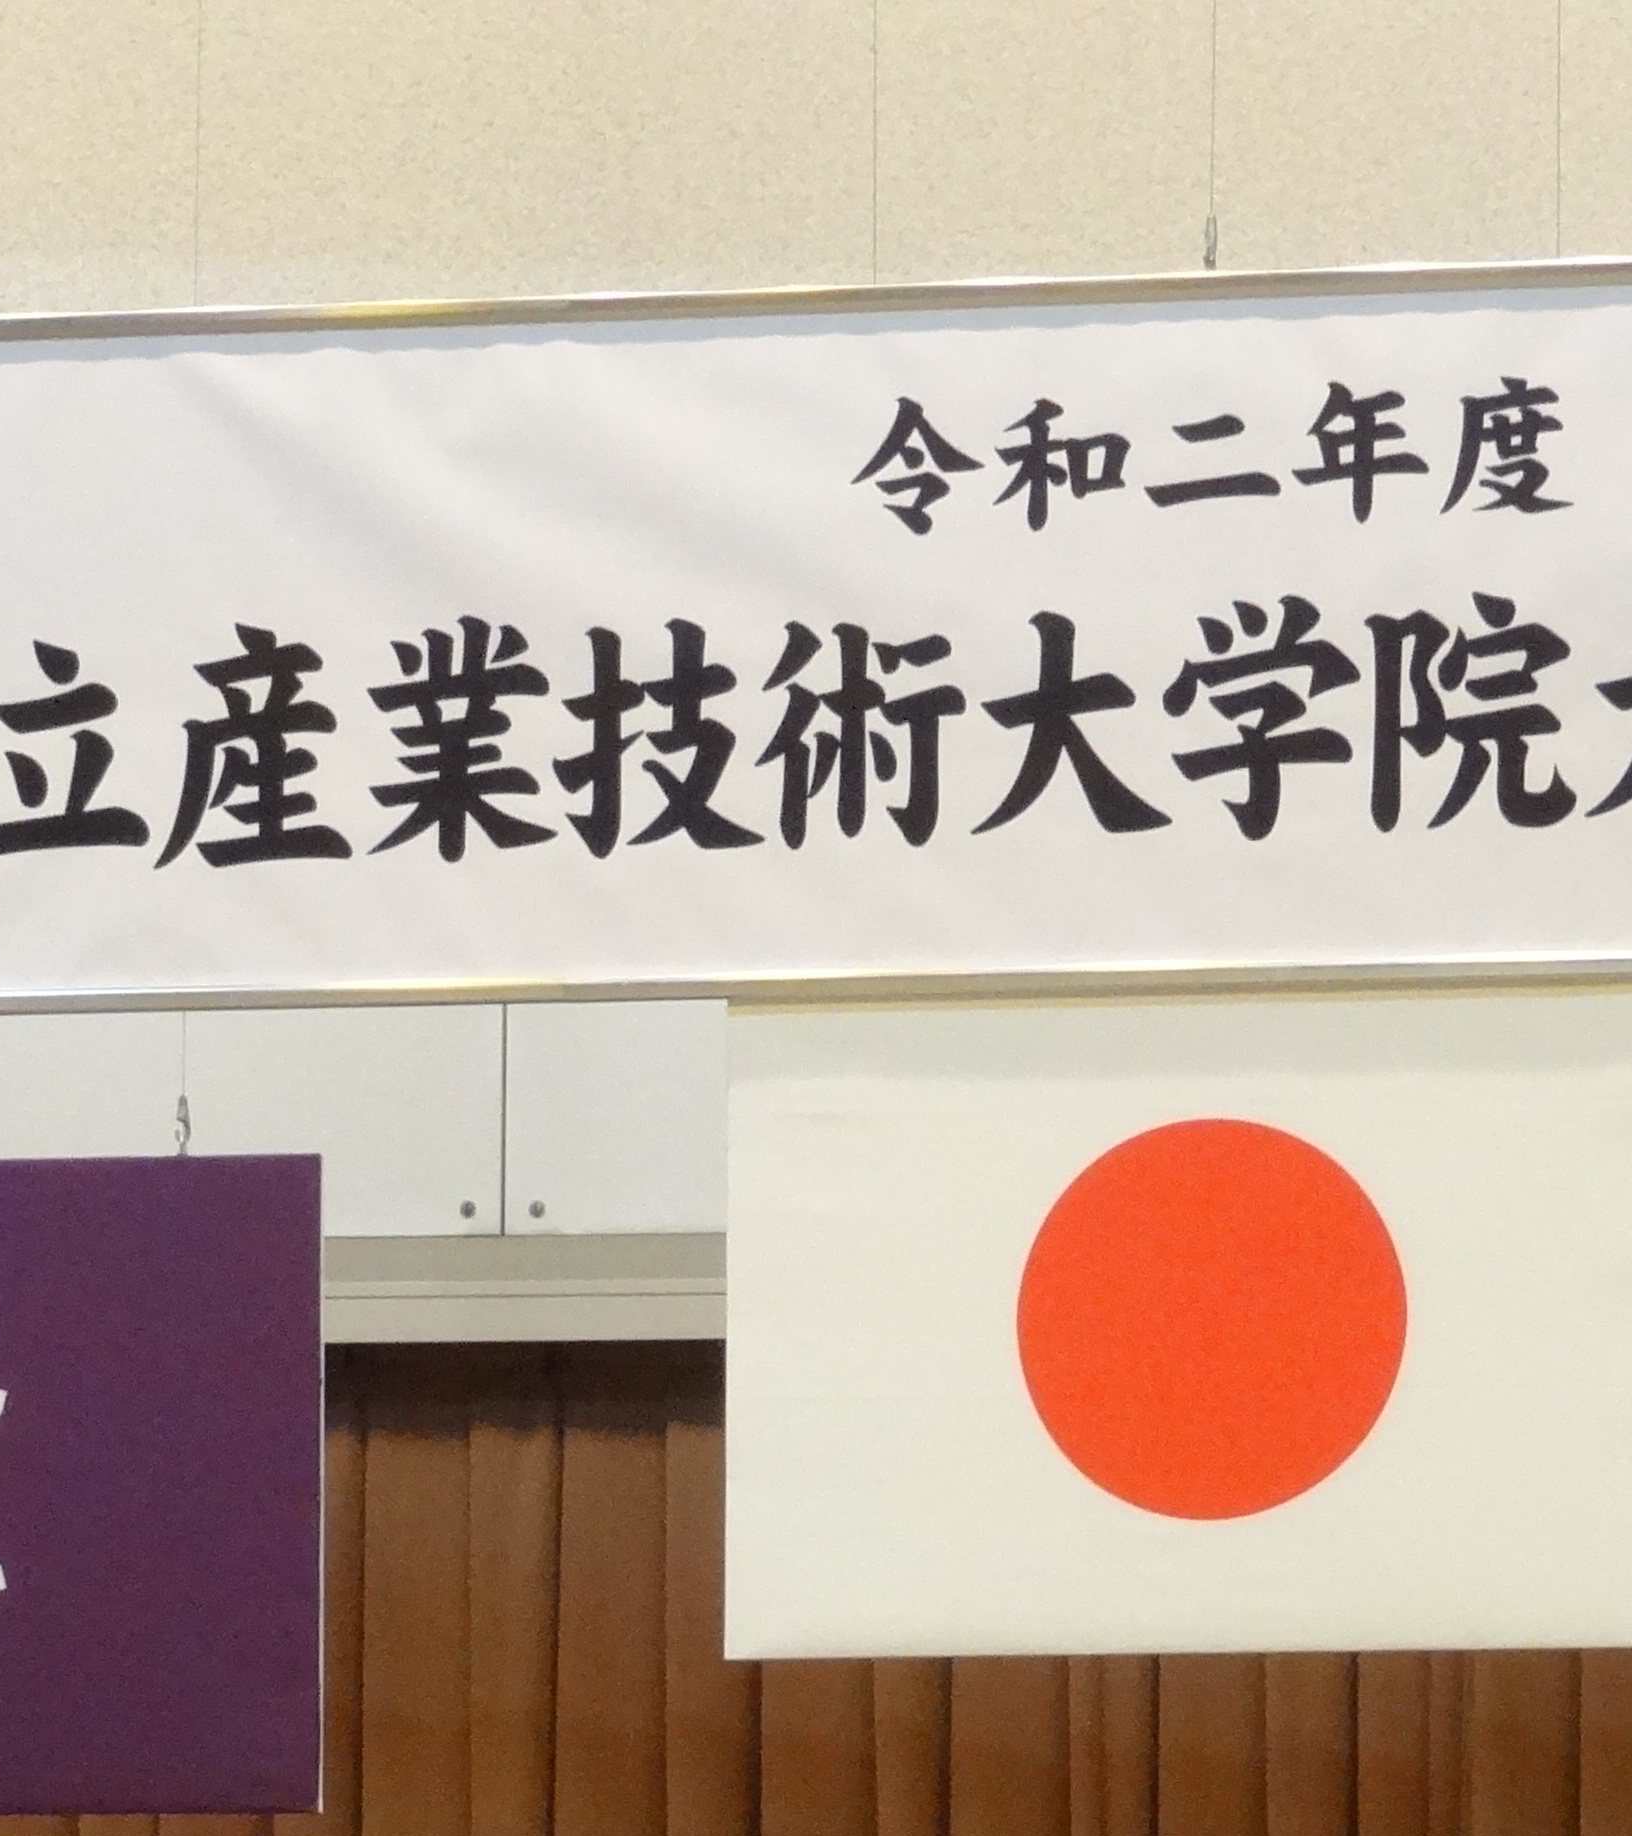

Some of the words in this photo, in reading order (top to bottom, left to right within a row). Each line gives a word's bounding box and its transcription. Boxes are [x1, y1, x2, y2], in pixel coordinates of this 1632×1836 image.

[850, 375, 1572, 536] 令和二年度
